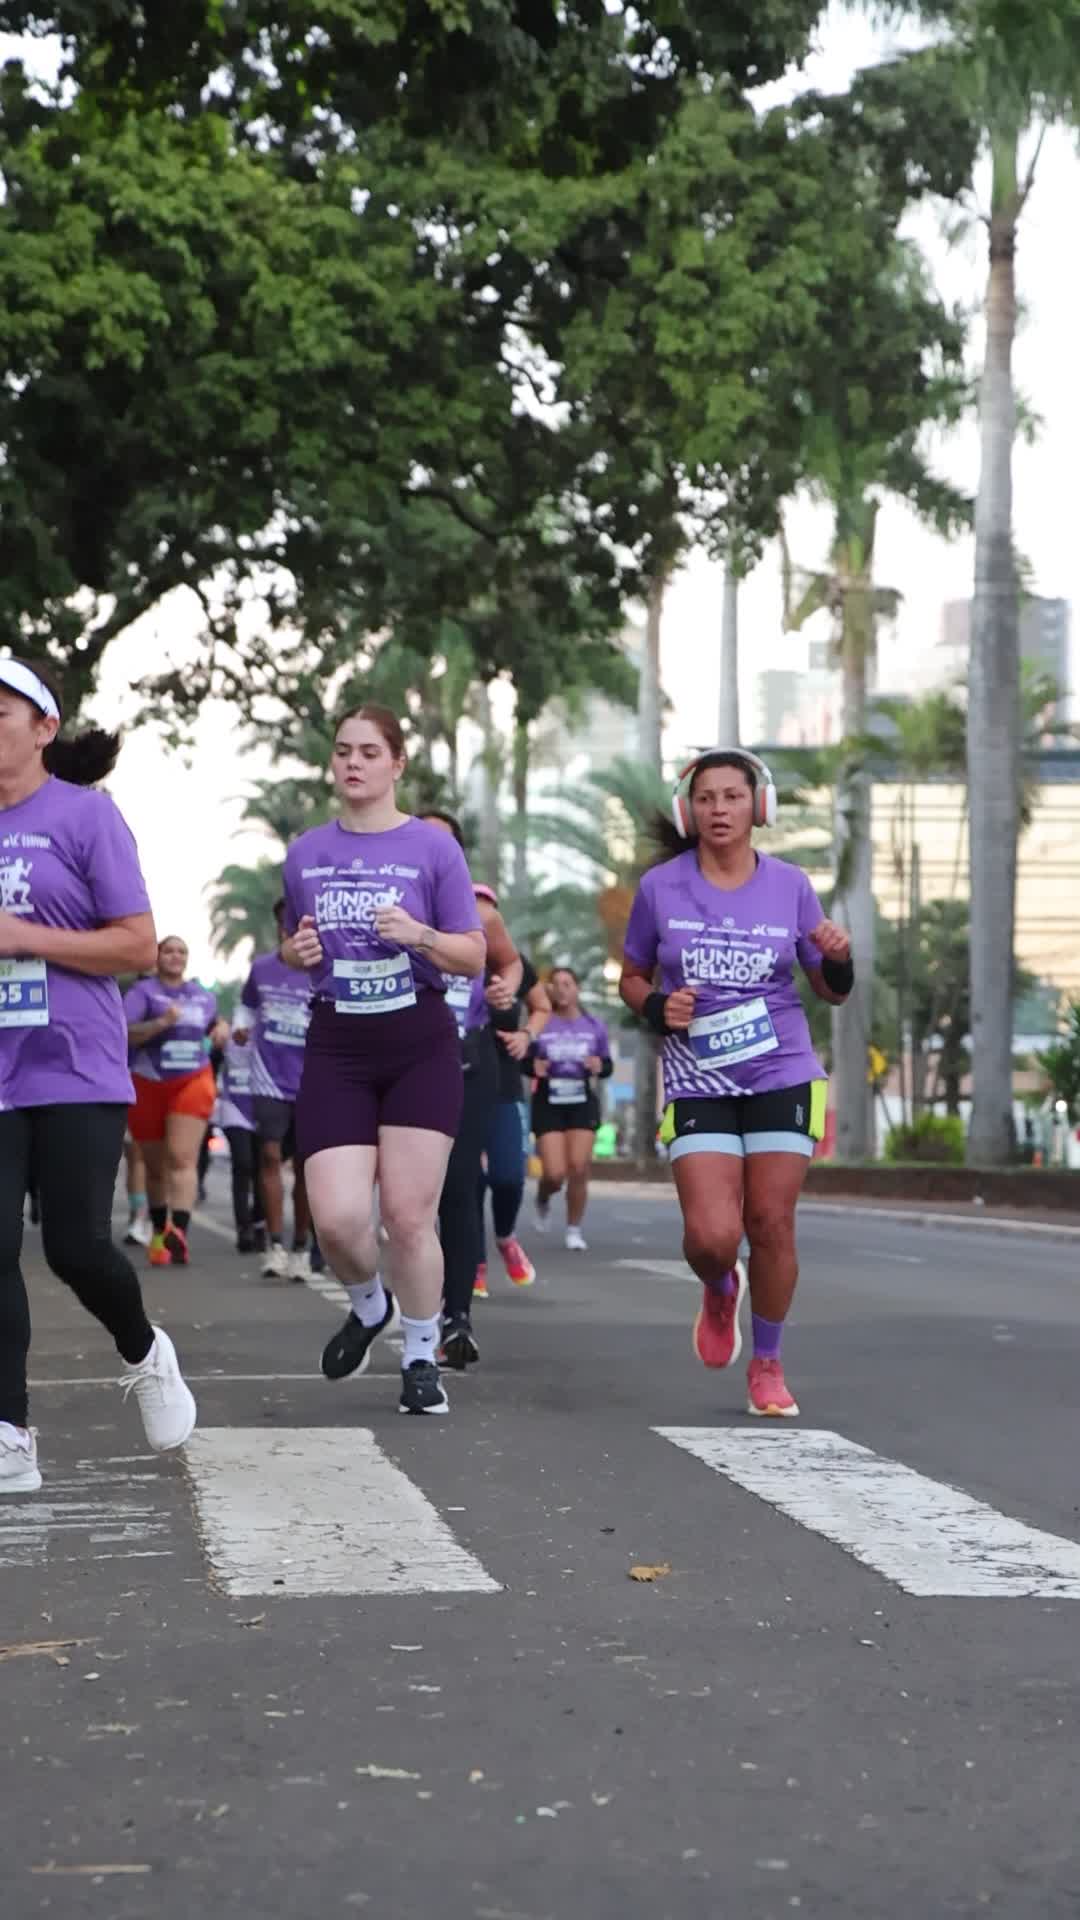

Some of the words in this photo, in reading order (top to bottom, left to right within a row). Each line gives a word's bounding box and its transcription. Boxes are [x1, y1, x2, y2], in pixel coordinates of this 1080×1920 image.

[314, 890, 391, 909] MUNDO
[316, 905, 376, 924] MELHO
[681, 948, 766, 968] MUNDO
[683, 963, 763, 982] MELHOR
[349, 976, 397, 995] 5470
[709, 1024, 757, 1050] 6052
